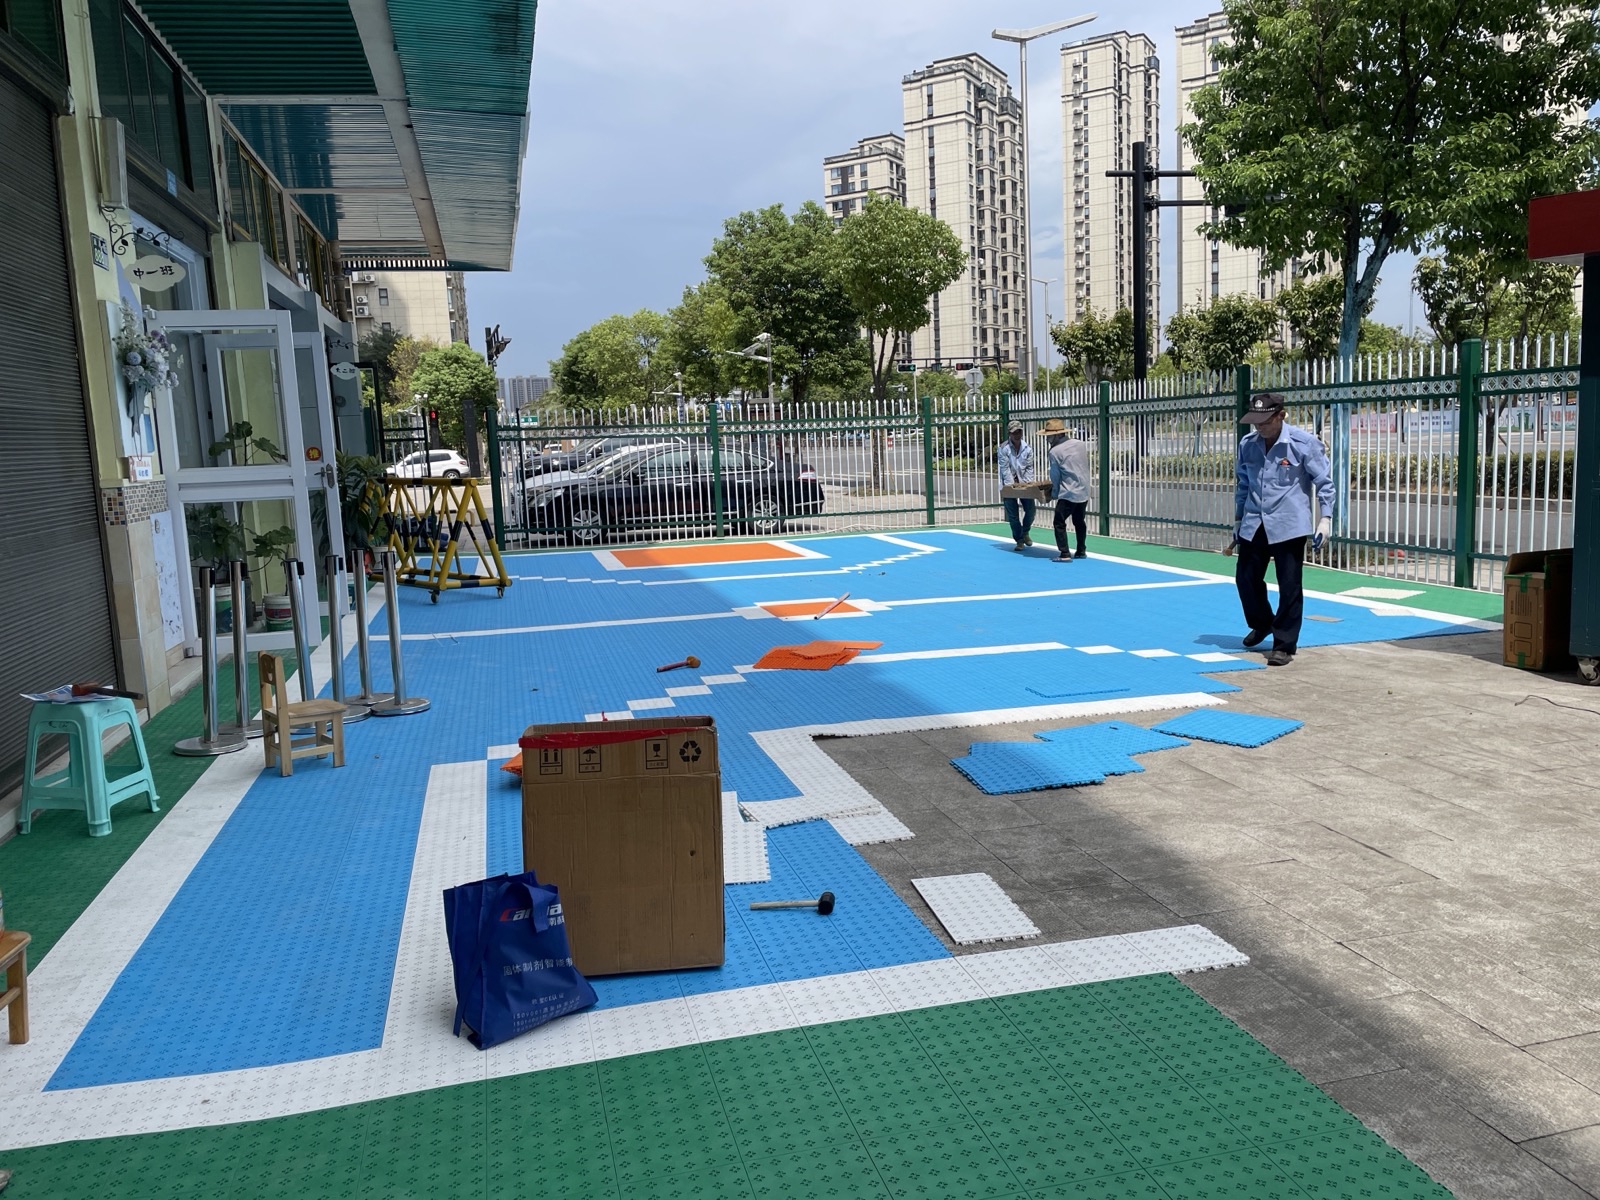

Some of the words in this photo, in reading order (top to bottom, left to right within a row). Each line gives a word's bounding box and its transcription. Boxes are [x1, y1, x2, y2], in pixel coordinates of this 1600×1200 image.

[133, 265, 175, 280] 中一班
[309, 448, 320, 459] 推
